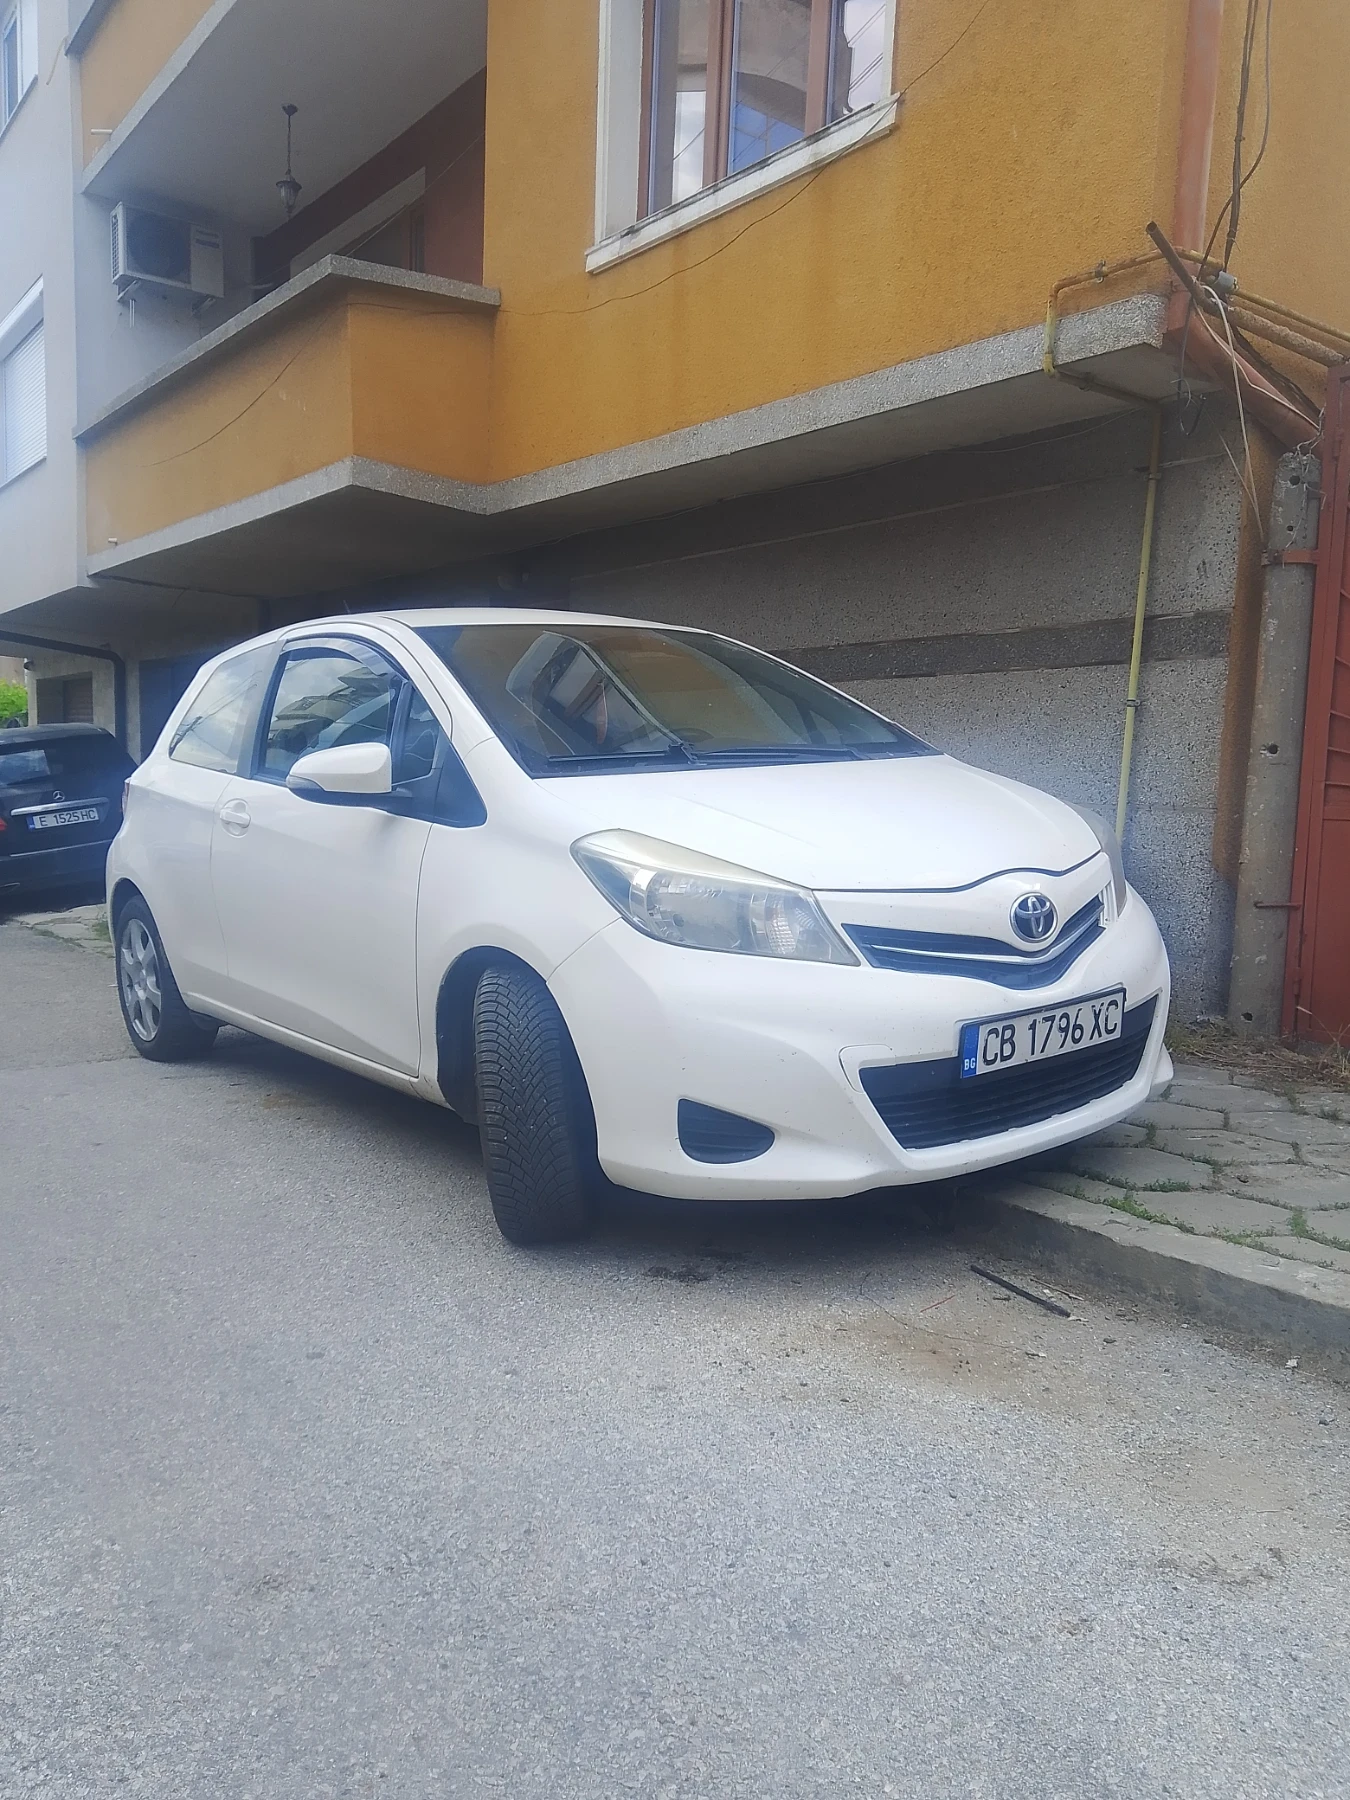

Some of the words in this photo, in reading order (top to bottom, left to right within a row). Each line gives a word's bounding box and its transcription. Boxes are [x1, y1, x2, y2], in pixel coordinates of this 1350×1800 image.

[39, 816, 48, 826] E
[53, 812, 80, 824] 1525
[81, 810, 96, 820] HC
[982, 1024, 1016, 1066] CB
[1028, 1008, 1084, 1056] 1796
[1089, 999, 1119, 1041] XC
[964, 1057, 976, 1070] BG
